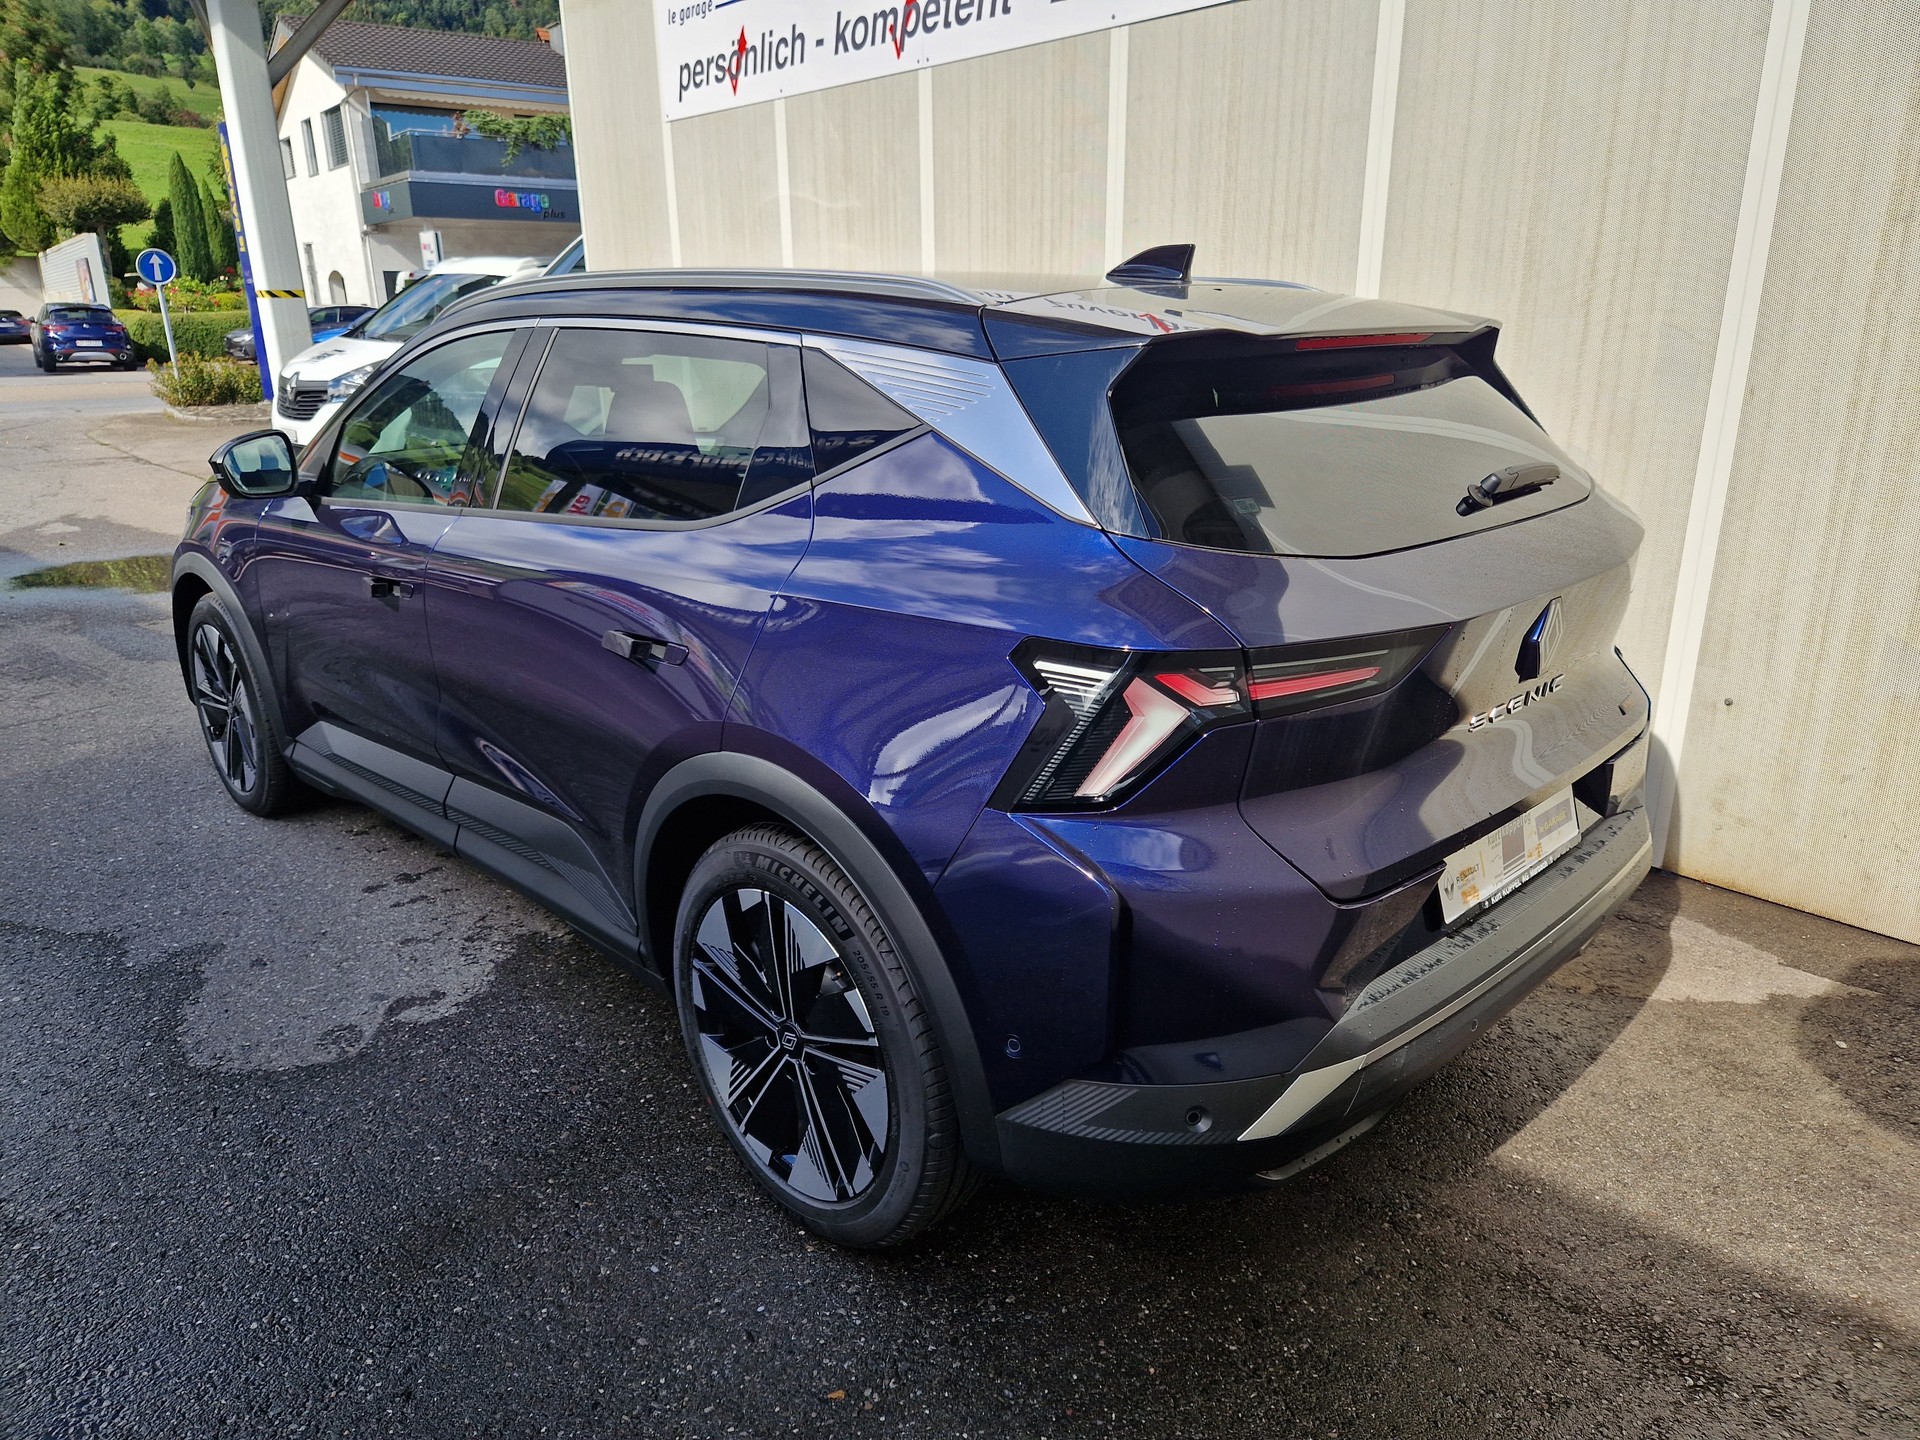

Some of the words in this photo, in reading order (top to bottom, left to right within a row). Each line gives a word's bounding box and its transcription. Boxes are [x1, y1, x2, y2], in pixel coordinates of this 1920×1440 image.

[668, 9, 677, 25] le
[679, 0, 713, 26] garage
[678, 23, 806, 103] persönlich
[495, 188, 550, 213] Garage
[543, 208, 566, 219] plus
[1468, 673, 1565, 733] SCENIC
[755, 855, 850, 935] MICHELIN
[853, 950, 880, 990] 205/55
[875, 992, 884, 1001] R
[880, 1005, 890, 1017] 19
